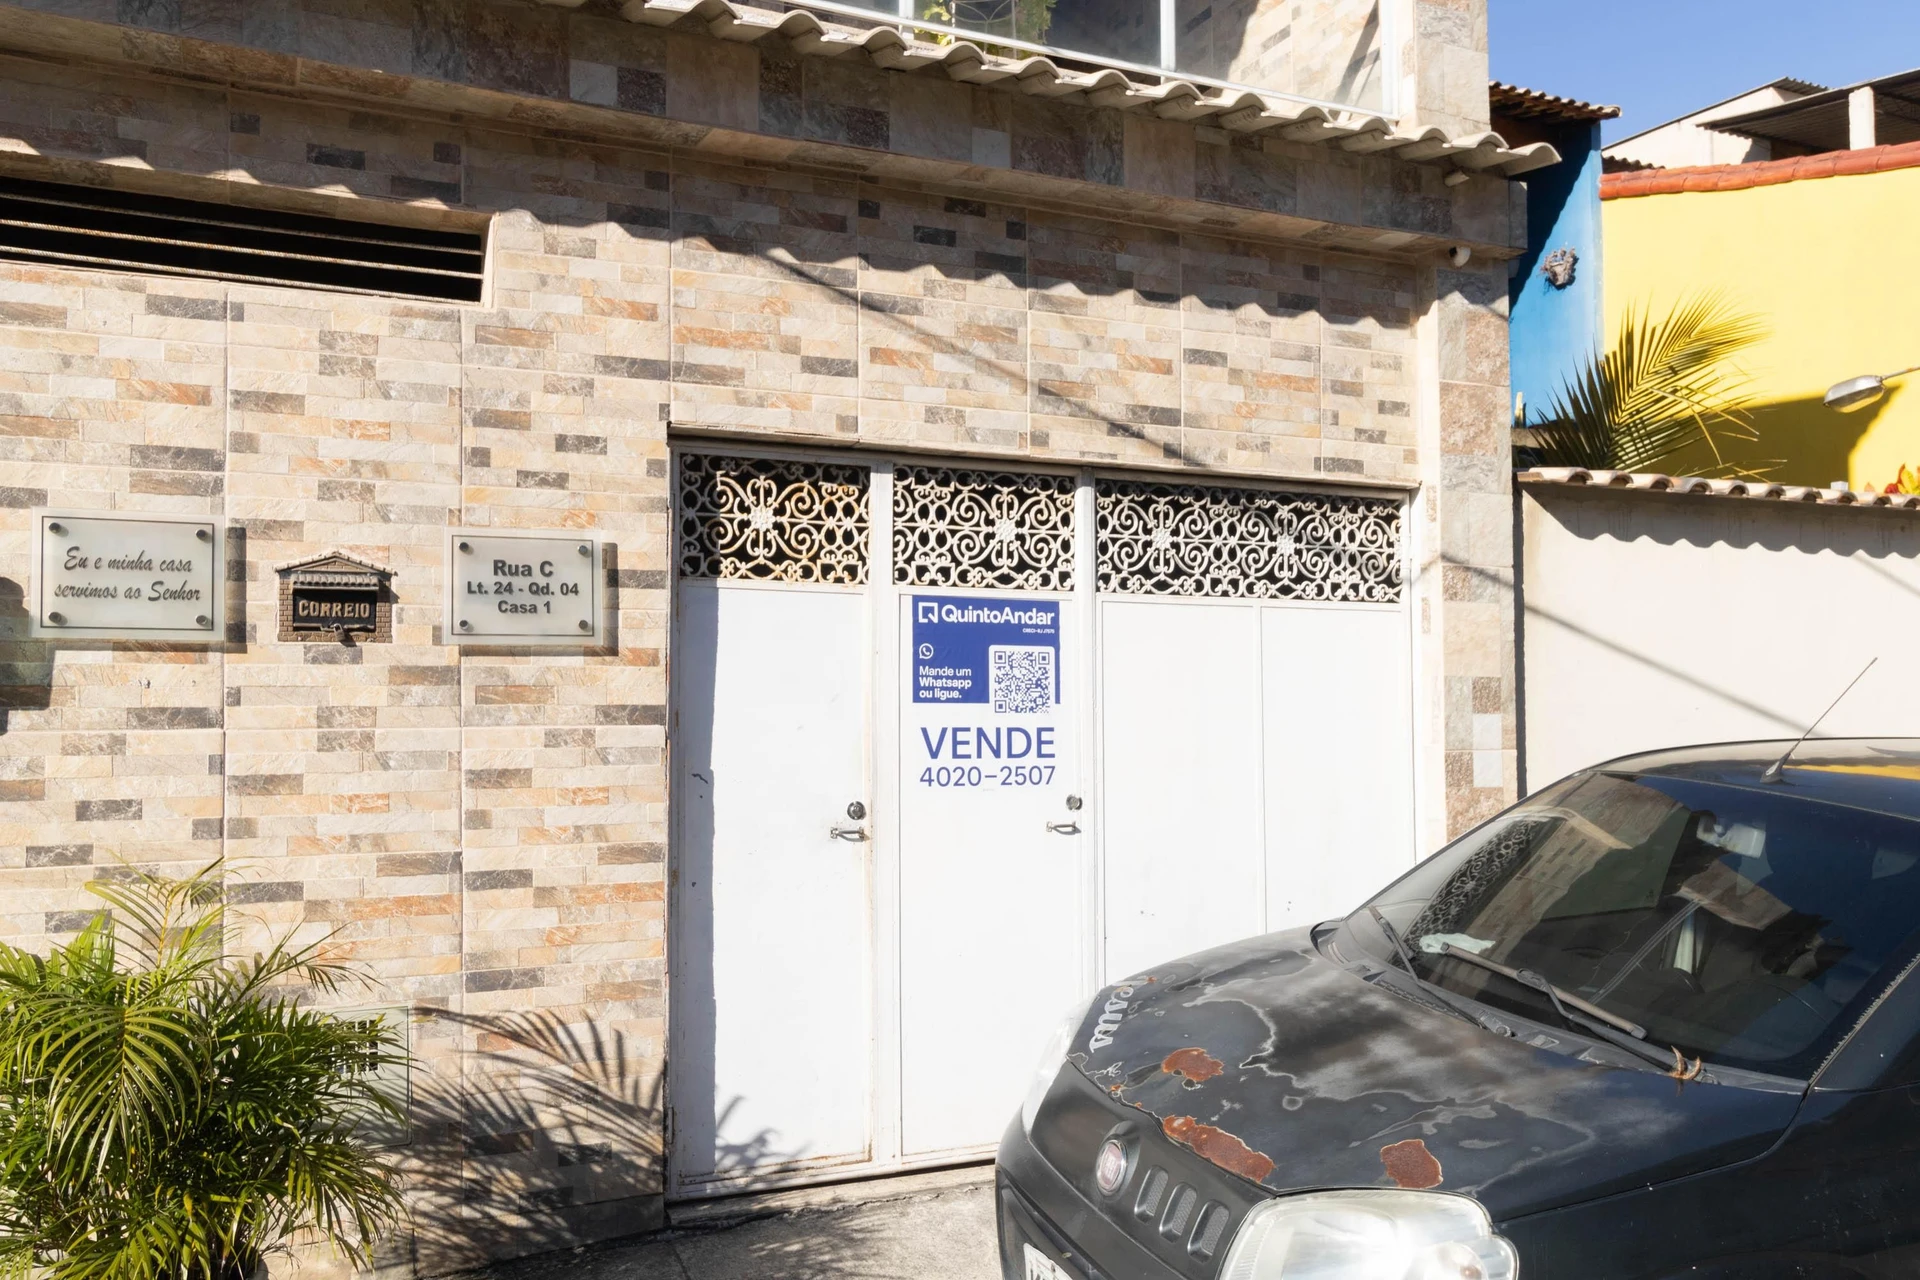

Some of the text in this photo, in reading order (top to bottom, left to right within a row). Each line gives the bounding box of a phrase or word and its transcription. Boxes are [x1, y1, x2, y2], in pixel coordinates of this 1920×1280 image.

[64, 546, 192, 572] Eu e minha casa
[493, 559, 554, 577] Rua C
[54, 580, 201, 602] servimos ao Senhor
[467, 581, 488, 595] Lt.
[494, 581, 514, 595] 24
[528, 582, 555, 596] Qd.
[560, 583, 579, 596] 04
[299, 600, 370, 618] CORREIO
[498, 600, 551, 614] Casa 1
[941, 604, 1055, 625] QuintoAndar
[919, 665, 972, 676] Mande um
[919, 676, 972, 689] Whatsapp
[919, 688, 962, 700] ou ligue.
[920, 727, 1056, 759] VENDE
[919, 766, 1056, 787] 4020-2507
